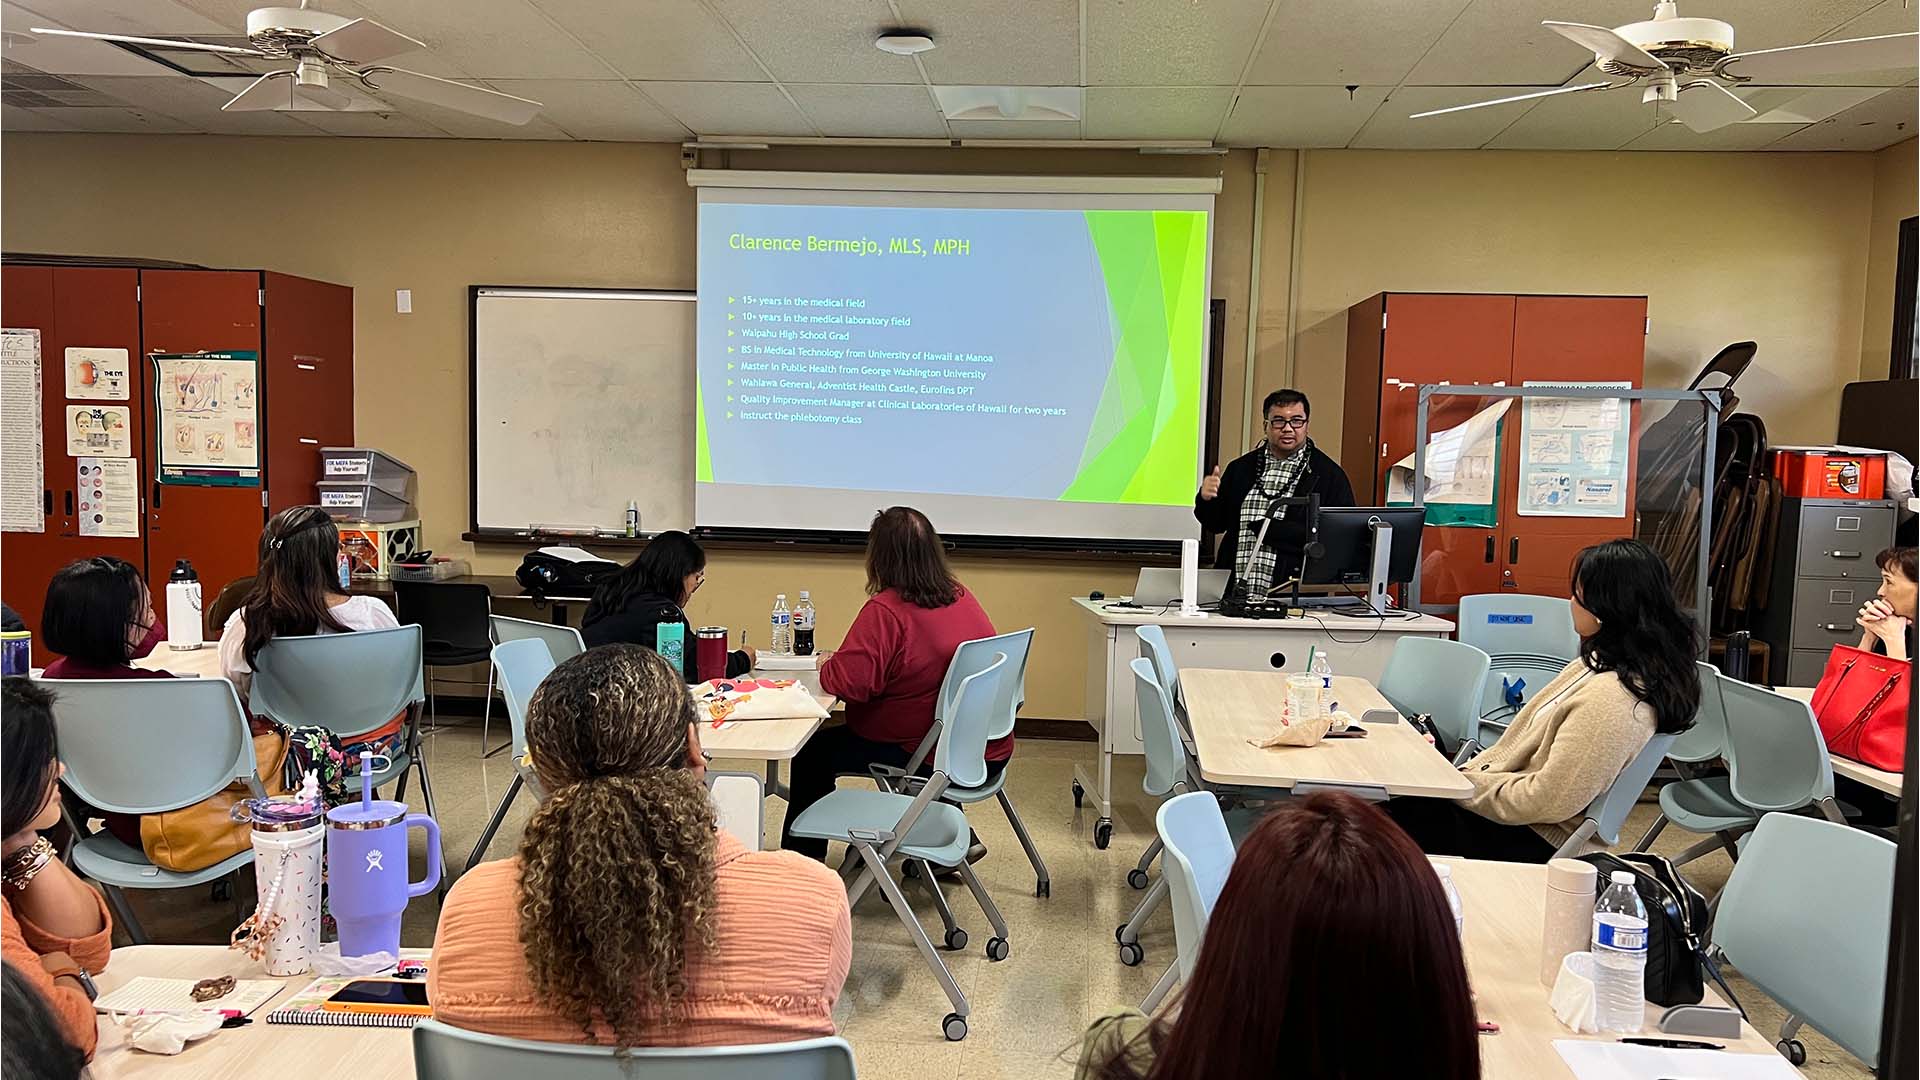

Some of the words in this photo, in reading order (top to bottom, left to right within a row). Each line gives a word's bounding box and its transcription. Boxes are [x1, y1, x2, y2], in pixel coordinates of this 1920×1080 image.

[729, 234, 802, 251] Clarence
[807, 236, 883, 256] Bermejo,
[889, 238, 927, 257] MLS,
[933, 239, 970, 255] MPH
[742, 296, 757, 304] 15+
[758, 298, 782, 306] years
[784, 297, 792, 305] in
[794, 297, 808, 306] the
[810, 298, 844, 307] medical
[846, 299, 866, 308] field
[742, 312, 757, 320] 10+
[759, 314, 782, 322] years
[784, 314, 791, 322] in
[793, 314, 808, 322] the
[810, 315, 843, 323] medical
[845, 316, 889, 327] laboratory
[890, 317, 911, 326] field
[741, 329, 777, 338] Waipahu
[779, 330, 797, 340] High
[799, 331, 827, 340] School
[829, 332, 850, 340] Grad
[764, 346, 796, 355] Medical
[799, 348, 844, 359] Technology
[846, 349, 866, 357] from
[868, 350, 911, 360] University
[923, 352, 953, 360] Hawaii
[965, 354, 994, 362] Manoa
[741, 362, 769, 370] Master
[782, 363, 807, 372] Public
[809, 364, 837, 373] Health
[839, 365, 859, 374] from
[861, 366, 891, 376] George
[893, 368, 942, 378] Washington
[943, 369, 987, 380] University
[780, 379, 816, 390] General,
[817, 382, 857, 390] Adventist
[859, 383, 887, 391] Health
[888, 384, 919, 394] Castle,
[921, 385, 955, 394] Eurofins
[957, 386, 975, 395] DPT
[741, 395, 771, 405] Quality
[773, 395, 828, 406] Improvement
[830, 398, 866, 408] Manager
[878, 400, 910, 408] Clinical
[911, 401, 965, 411] Laboratories
[966, 404, 976, 412] of
[977, 404, 1007, 413] Hawaii
[1009, 405, 1022, 414] for
[1024, 406, 1042, 414] two
[1043, 408, 1067, 416] years
[741, 411, 773, 419] Instruct
[774, 412, 790, 420] the
[790, 413, 840, 424] phlebotomy
